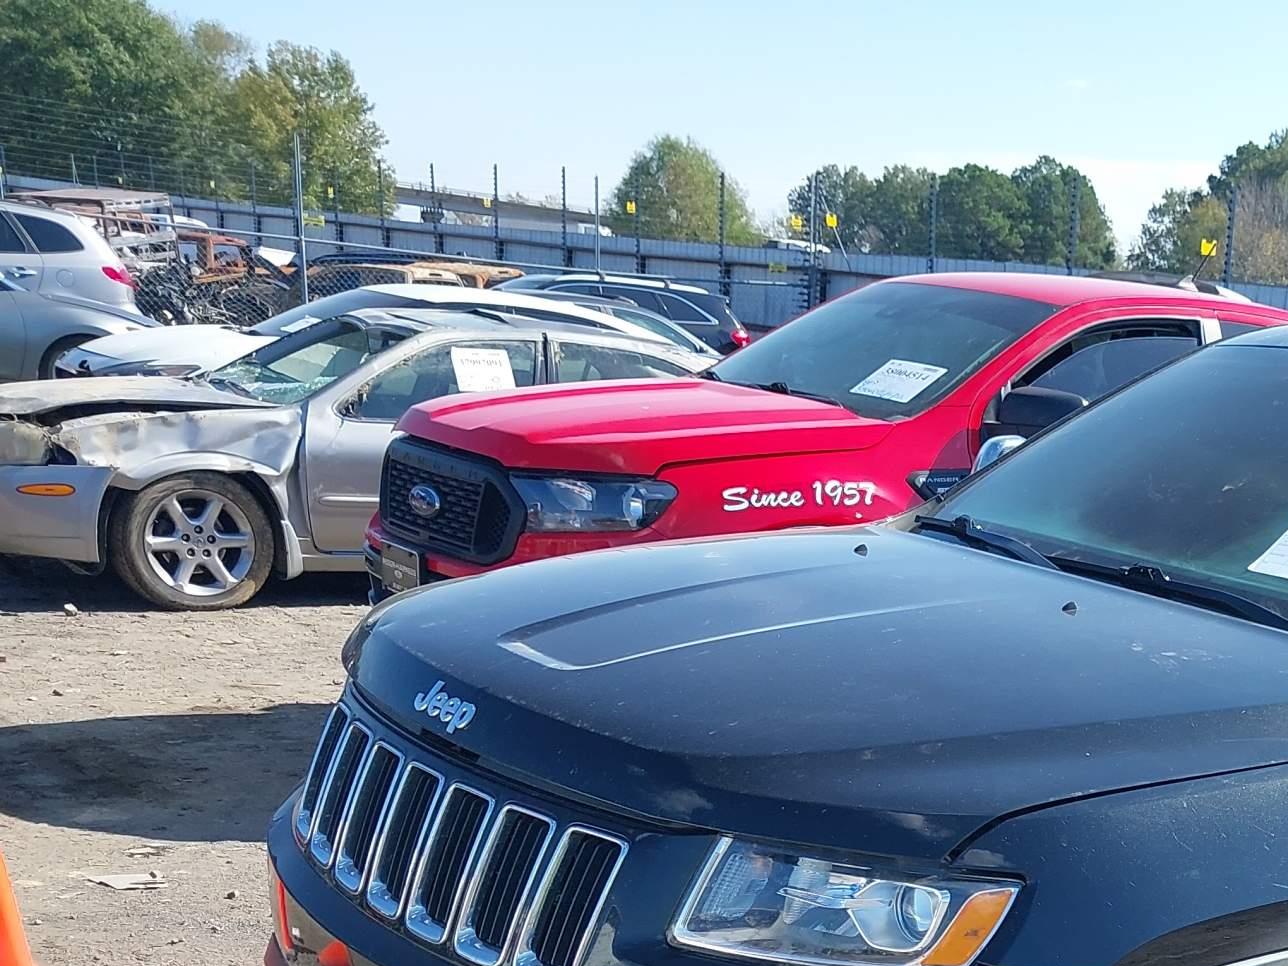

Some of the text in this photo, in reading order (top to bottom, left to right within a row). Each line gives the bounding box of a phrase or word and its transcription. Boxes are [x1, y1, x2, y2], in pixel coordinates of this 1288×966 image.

[722, 479, 877, 512] Since 1957
[413, 679, 477, 734] Jeep
